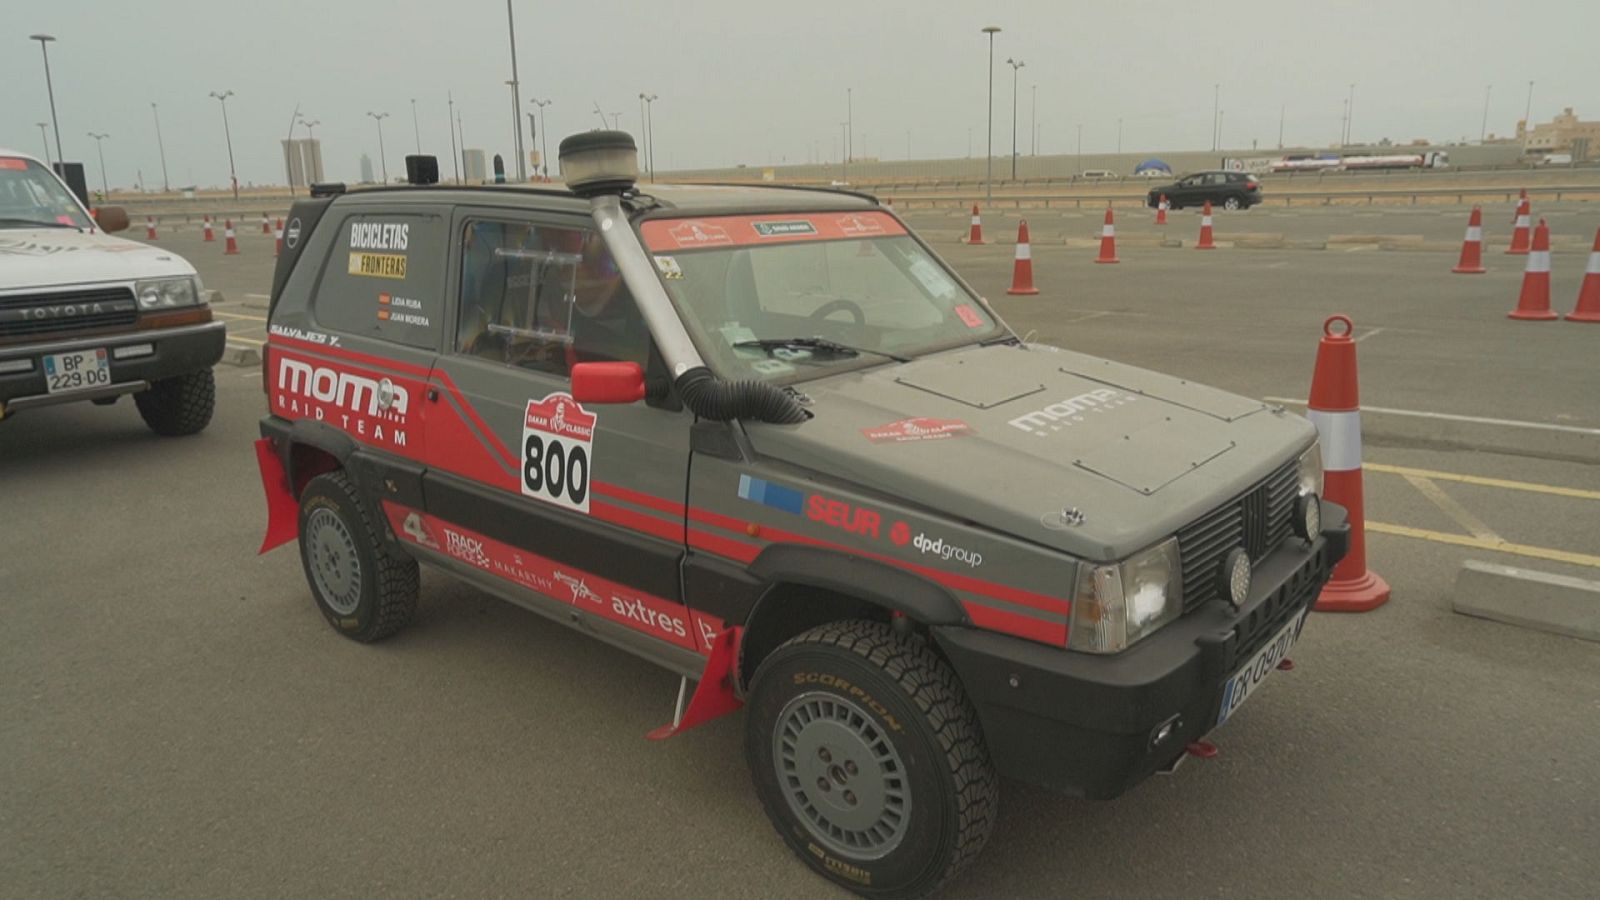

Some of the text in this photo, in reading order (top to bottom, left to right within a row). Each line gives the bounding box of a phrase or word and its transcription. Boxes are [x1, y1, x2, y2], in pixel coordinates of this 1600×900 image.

[350, 223, 409, 250] BICICLETAS
[361, 255, 406, 277] FRONTERAS
[20, 303, 102, 319] TOYOTA
[270, 324, 327, 344] SALVAJES
[62, 354, 83, 371] BP
[50, 368, 108, 391] 229 DG
[279, 394, 406, 447] RAID TEAM
[527, 414, 592, 437] DAKAR CLASSIC
[524, 434, 588, 505] 800
[807, 495, 881, 540] SEUR
[443, 528, 484, 558] TRACK
[913, 533, 983, 568] dpdgroup
[611, 596, 686, 638] axtres
[793, 672, 901, 732] SCORPION
